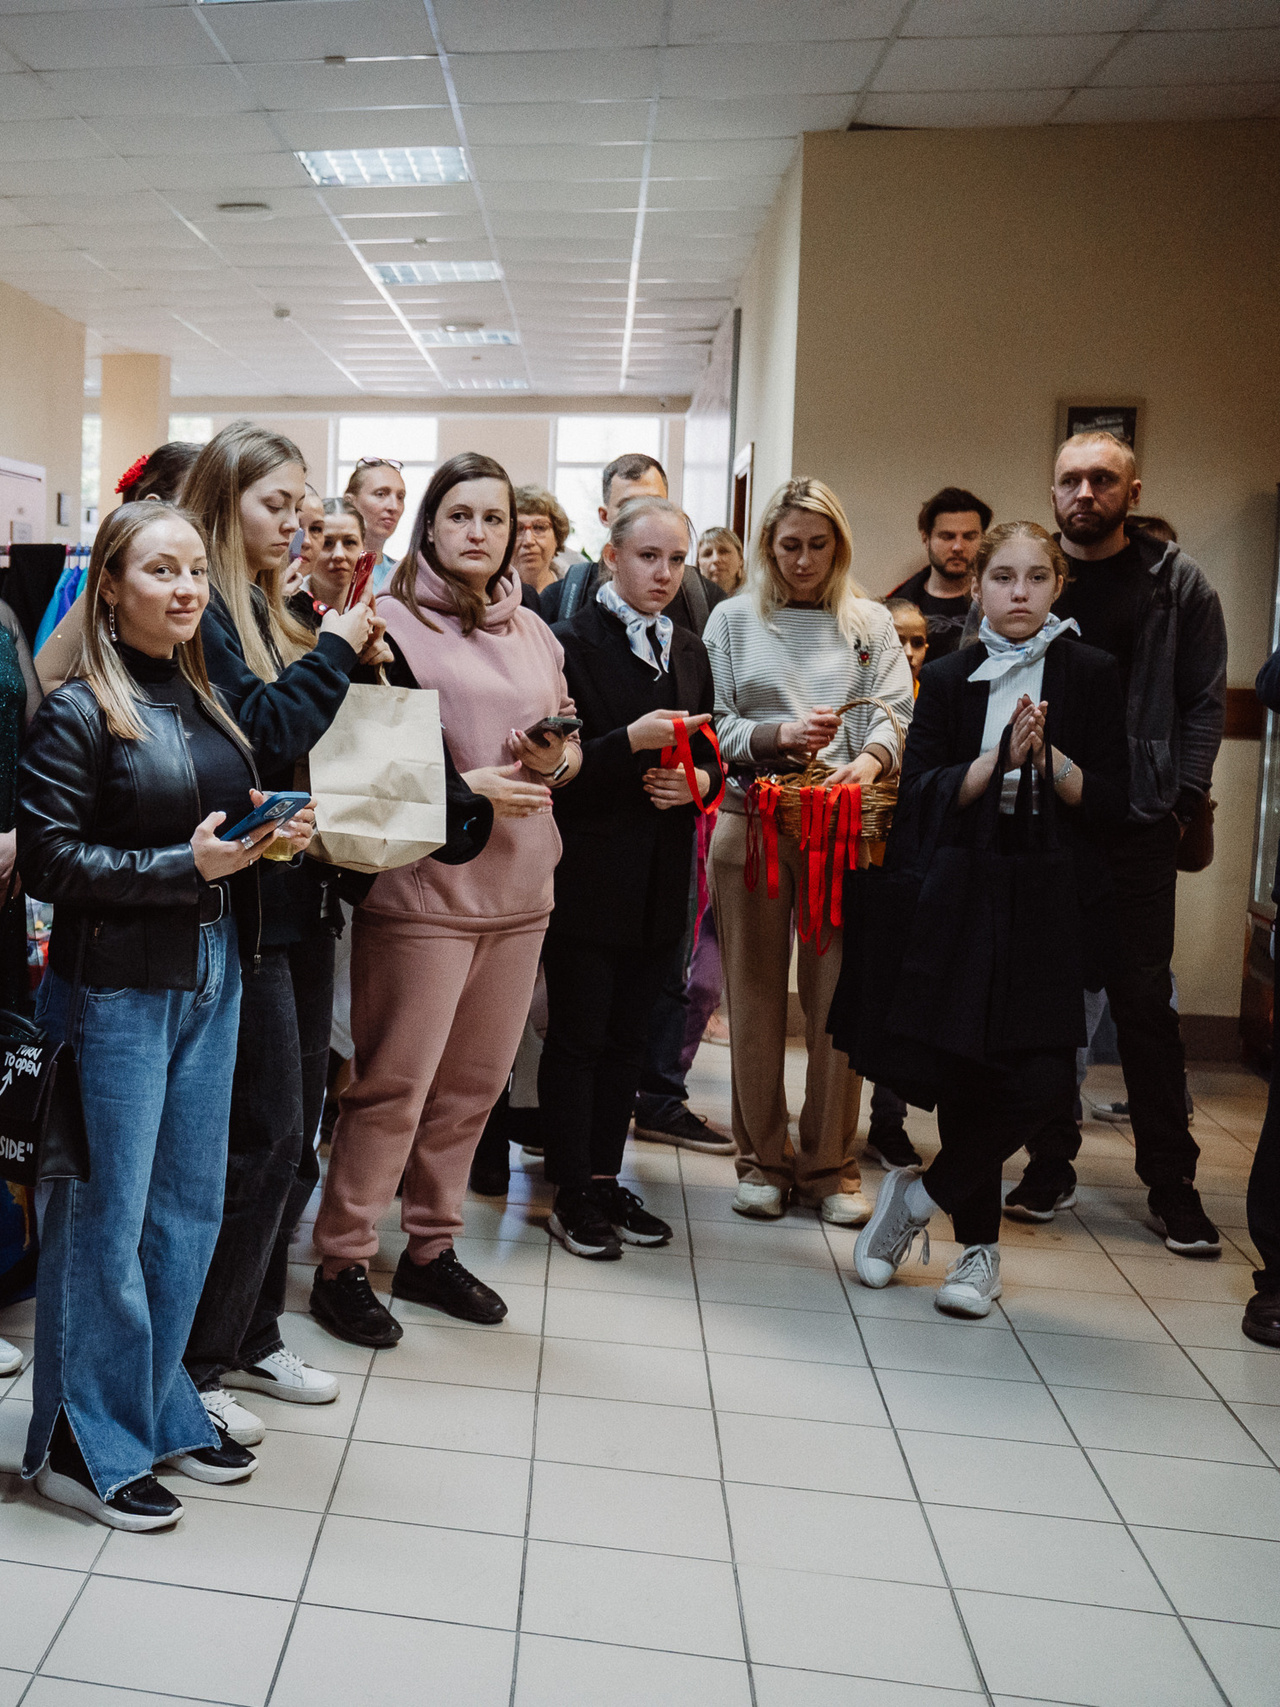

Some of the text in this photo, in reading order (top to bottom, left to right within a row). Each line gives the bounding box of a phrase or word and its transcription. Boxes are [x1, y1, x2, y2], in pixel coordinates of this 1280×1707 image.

[16, 1044, 43, 1061] TURN
[4, 1051, 42, 1078] TO OPEN
